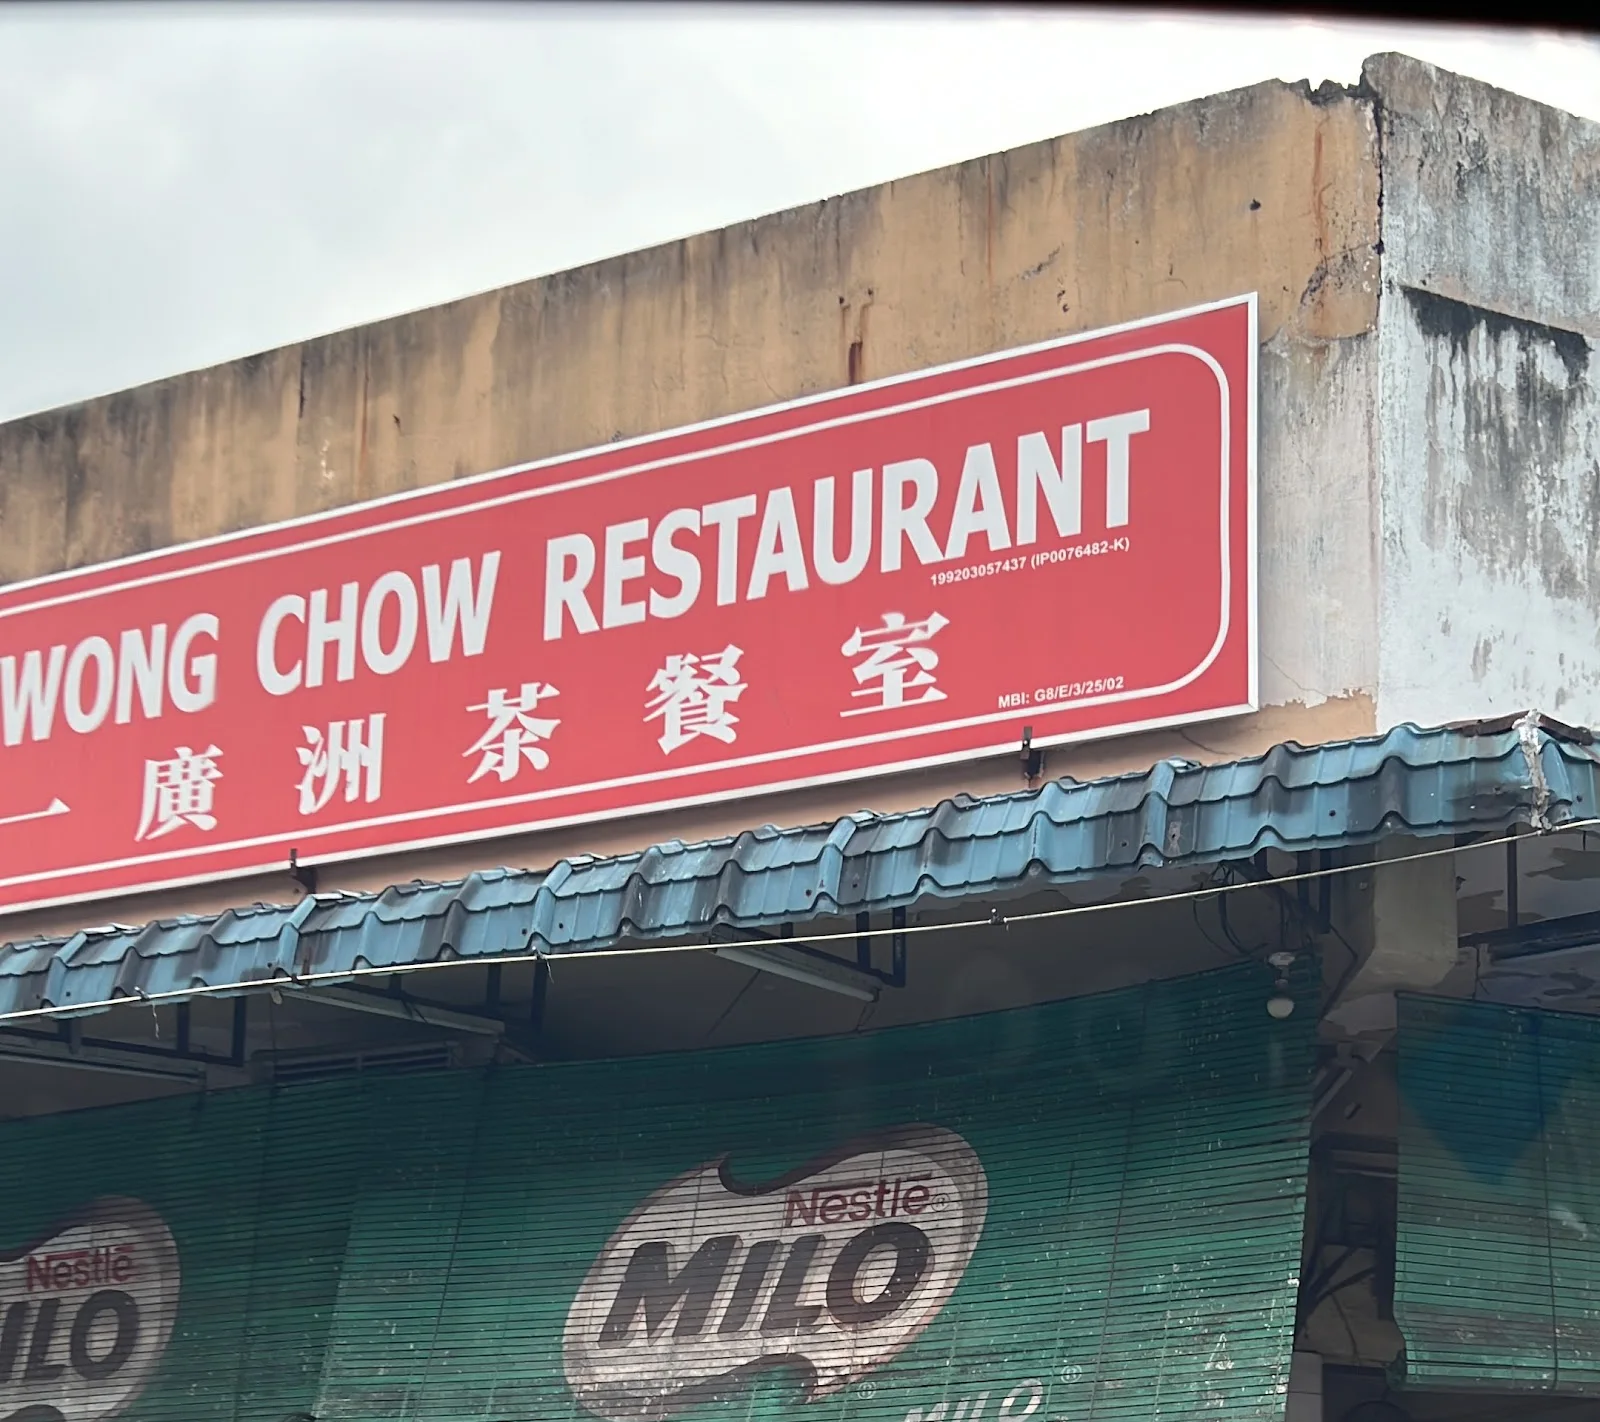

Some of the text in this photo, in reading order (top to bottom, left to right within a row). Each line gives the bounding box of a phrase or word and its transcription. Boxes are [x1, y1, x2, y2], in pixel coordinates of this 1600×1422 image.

[0, 408, 1150, 747] WONG CHOW RESTAURANT
[930, 537, 1130, 586] 199203057437 (IP0076482-K)
[998, 676, 1124, 708] MBI: G8/E/3/25/02
[598, 1221, 937, 1349] MILO
